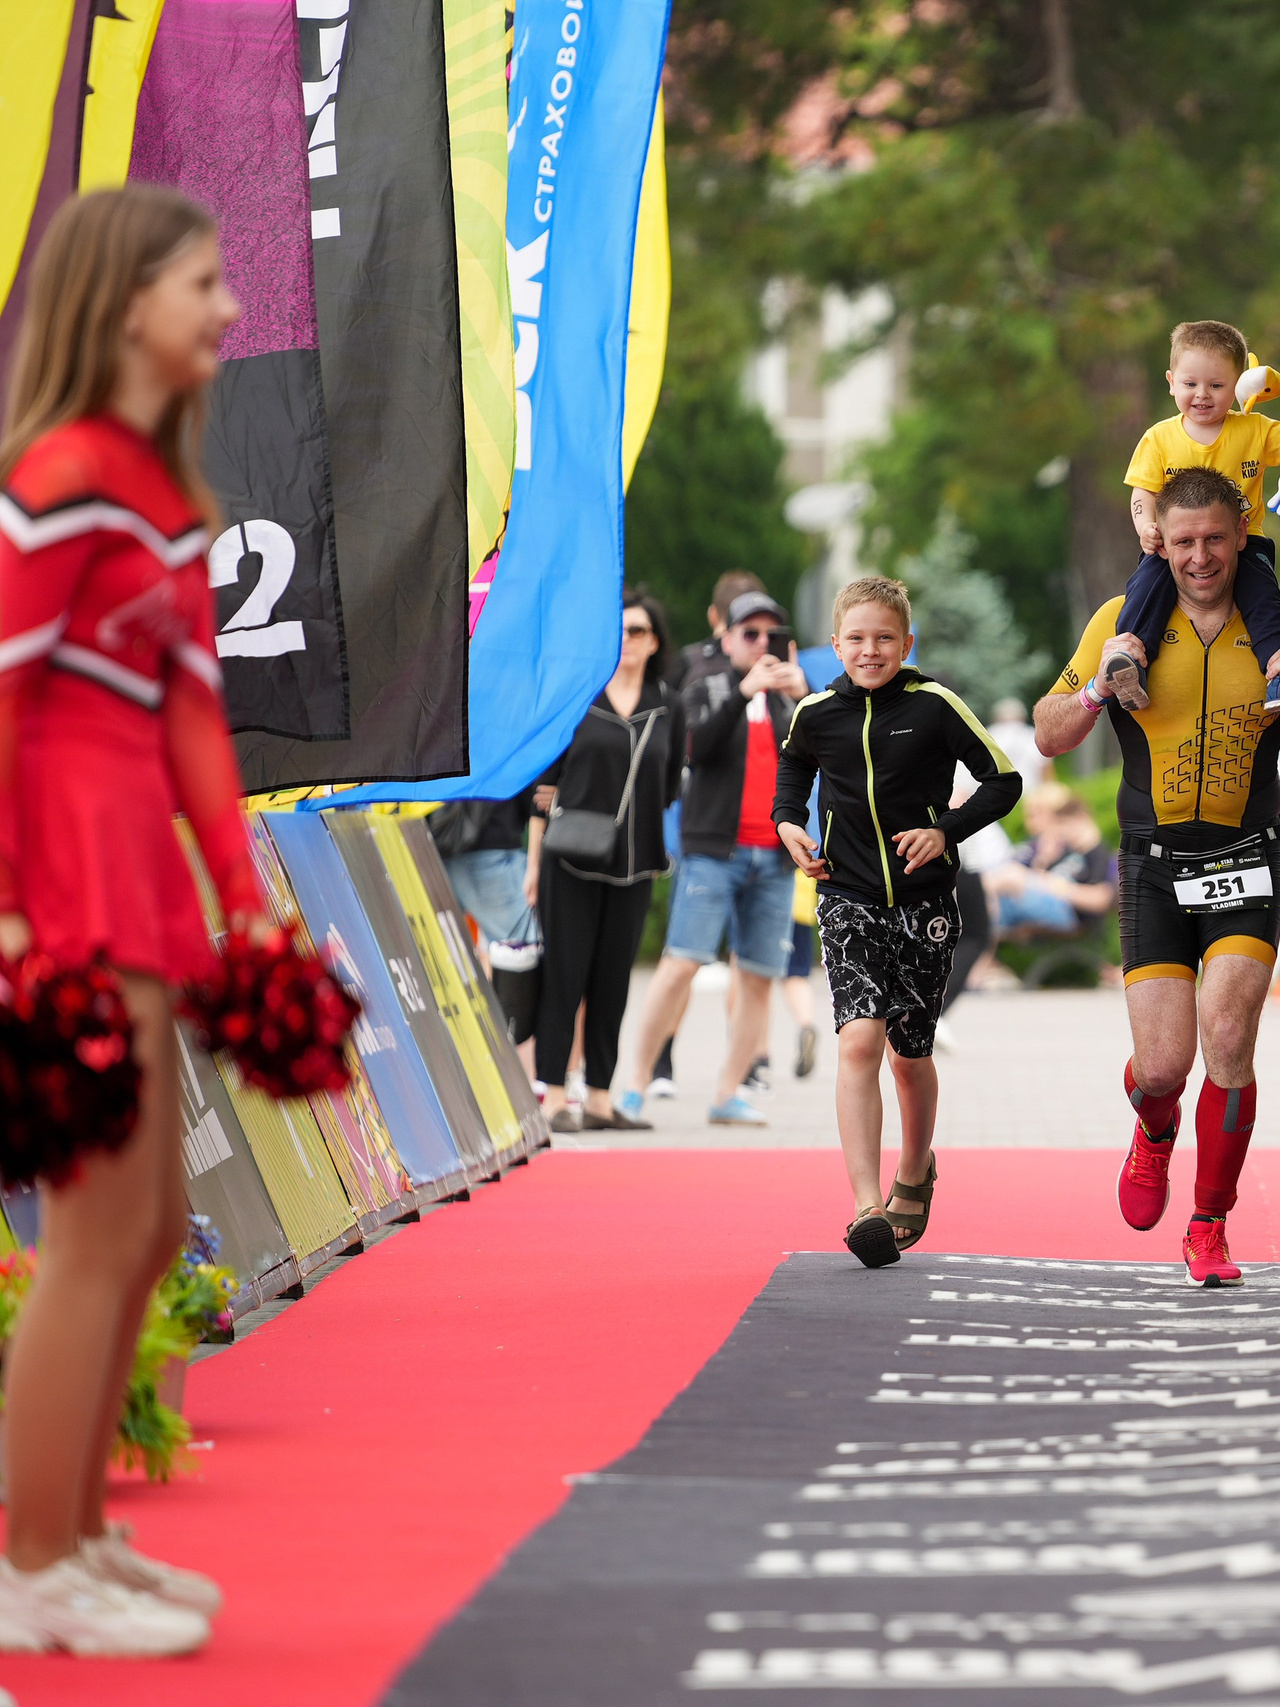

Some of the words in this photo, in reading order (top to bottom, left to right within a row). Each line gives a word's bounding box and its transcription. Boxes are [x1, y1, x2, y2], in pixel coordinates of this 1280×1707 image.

[1242, 467, 1258, 479] KIDS
[1202, 876, 1245, 900] 251
[1211, 899, 1244, 910] VLADIMIR
